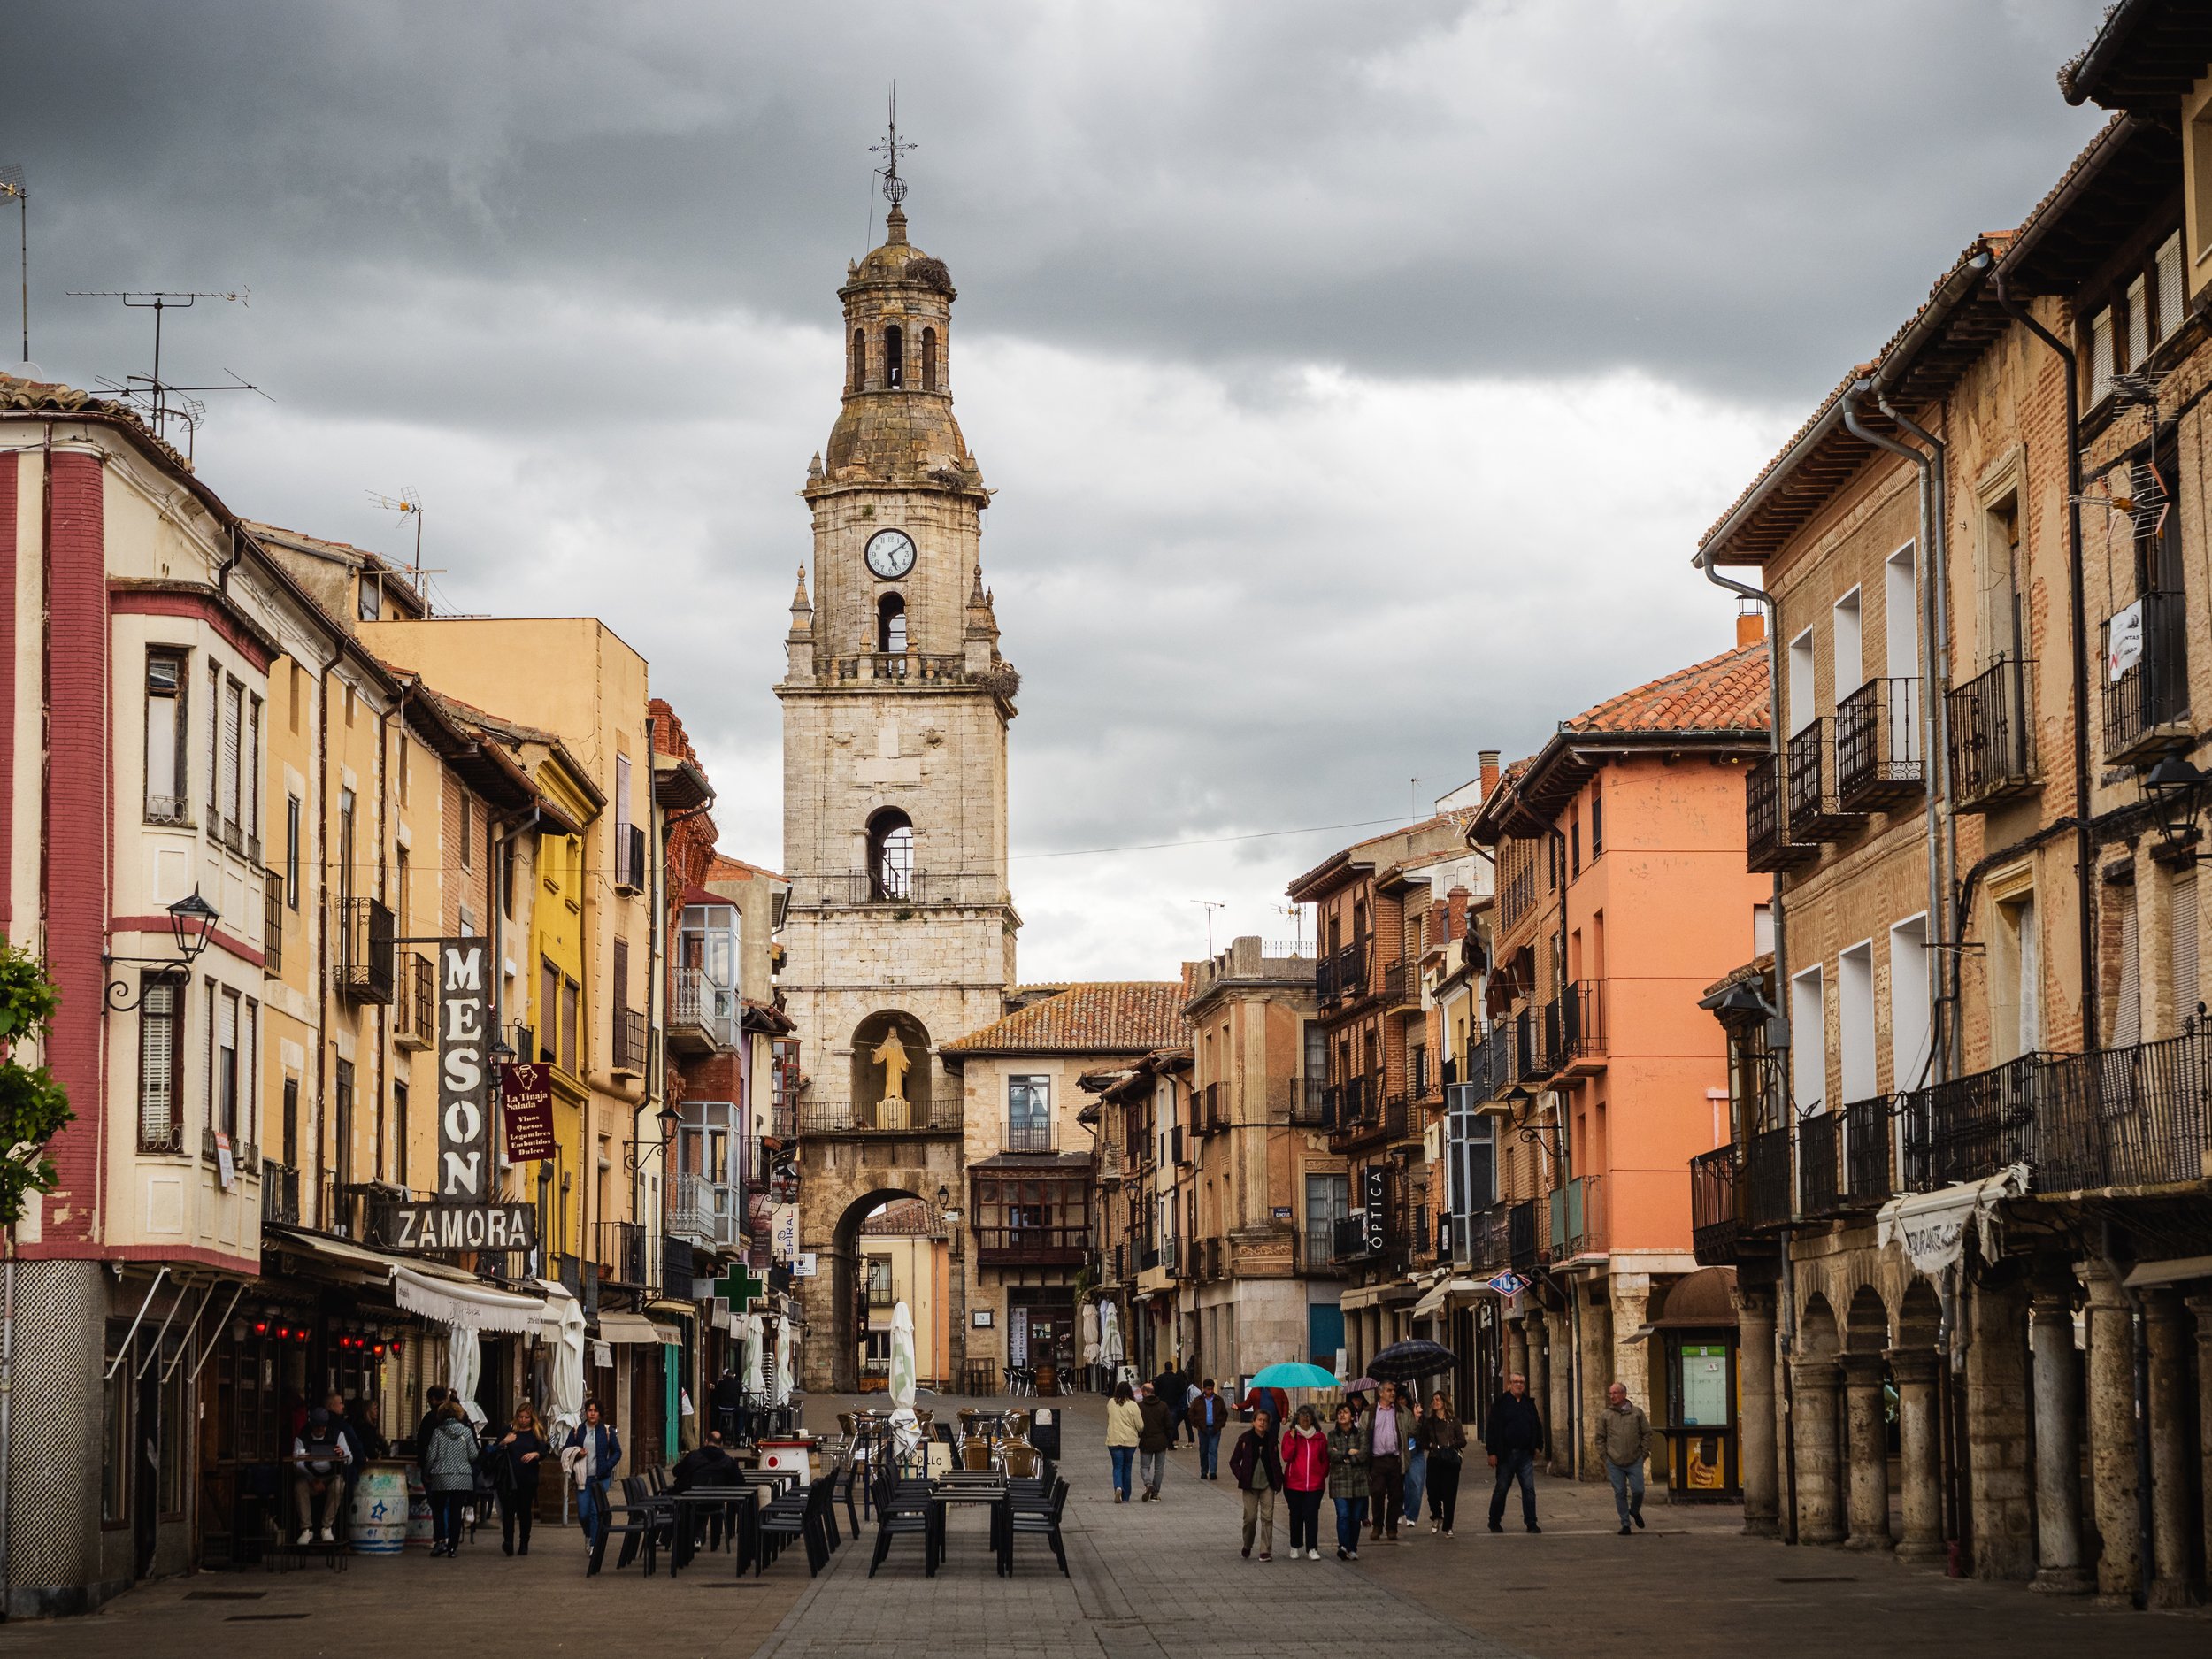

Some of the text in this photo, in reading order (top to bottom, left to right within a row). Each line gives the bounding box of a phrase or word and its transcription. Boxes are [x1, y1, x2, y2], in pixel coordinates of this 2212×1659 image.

[444, 947, 482, 1195] MESON
[506, 1090, 548, 1103] La Tinaja
[506, 1101, 536, 1110] Salada
[510, 1131, 551, 1141] Legumbres
[511, 1138, 551, 1148] Embutidos
[1369, 1171, 1383, 1248] ÓPTICA
[398, 1209, 527, 1248] ZAMORA
[783, 1210, 794, 1256] SPIRAL
